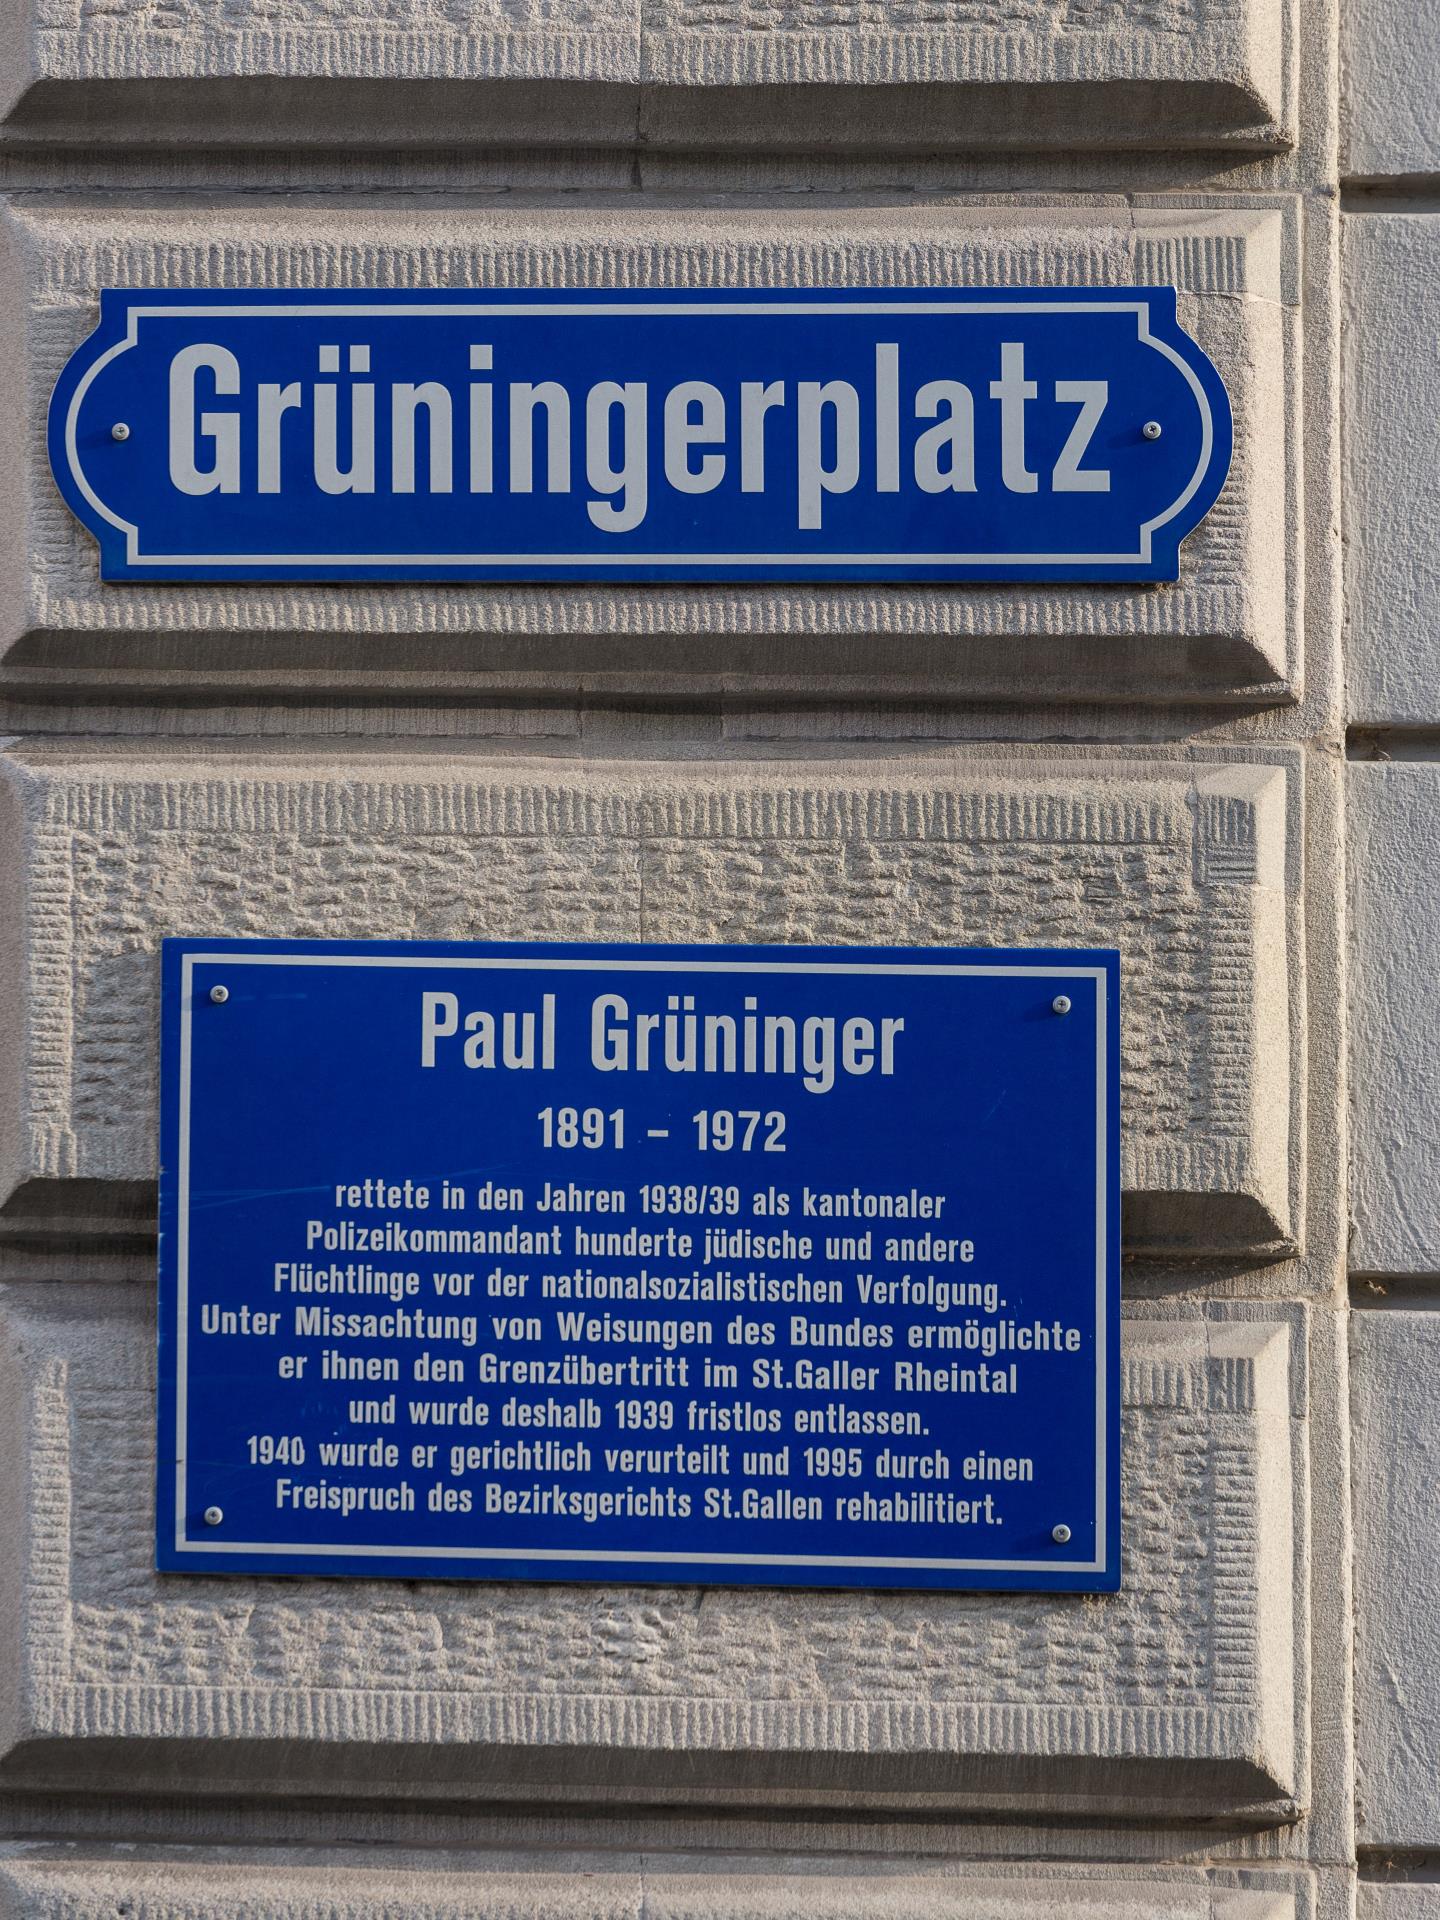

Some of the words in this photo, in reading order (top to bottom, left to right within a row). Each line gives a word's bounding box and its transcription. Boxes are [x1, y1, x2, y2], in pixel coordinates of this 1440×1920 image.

[170, 343, 1110, 532] Grüningerplatz
[422, 992, 555, 1069] Paul
[592, 994, 904, 1093] Grüninger
[538, 1108, 623, 1148] 1891
[693, 1111, 785, 1151] 1972
[336, 1179, 429, 1209] rettete
[443, 1181, 464, 1209] in
[479, 1182, 523, 1210] den
[537, 1183, 624, 1212] Jahren
[640, 1185, 739, 1214] 1938/39
[753, 1187, 789, 1215] als
[804, 1187, 945, 1218] kantonaler
[307, 1221, 561, 1254] Polizeikommandant
[576, 1226, 692, 1257] hunderte
[704, 1229, 812, 1264] jüdische
[826, 1232, 871, 1260] und
[886, 1233, 973, 1262] andere
[275, 1263, 419, 1301] Flüchtlinge
[433, 1274, 474, 1295] vor
[488, 1268, 529, 1296] der
[543, 1269, 842, 1303] nationalsozialistischen
[857, 1275, 1006, 1313] Verfolgung.
[202, 1305, 280, 1334] Unter
[296, 1307, 476, 1346] Missachtung
[493, 1318, 541, 1340] von
[557, 1312, 712, 1350] Weisungen
[728, 1315, 775, 1345] des
[791, 1317, 893, 1347] Bundes
[909, 1320, 1080, 1356] ermöglichte
[279, 1357, 307, 1378] er
[323, 1350, 398, 1380] ihnen
[414, 1352, 463, 1381] den
[480, 1353, 688, 1386] Grenzübertritt
[705, 1358, 737, 1387] im
[753, 1359, 879, 1390] St.Galler
[896, 1362, 1016, 1393] Rheintal
[350, 1395, 395, 1423] und
[409, 1396, 488, 1425] wurde
[502, 1397, 600, 1428] deshalb
[616, 1400, 673, 1429] 1939
[688, 1401, 781, 1432] fristlos
[795, 1404, 928, 1435] entlassen.
[248, 1436, 305, 1465] 1940
[319, 1438, 398, 1467] wurde
[412, 1446, 437, 1468] er
[451, 1440, 590, 1475] gerichtlich
[605, 1444, 729, 1474] verurteilt
[744, 1446, 788, 1475] und
[804, 1448, 861, 1477] 1995
[876, 1449, 949, 1479] durch
[964, 1451, 1032, 1480] einen
[277, 1479, 414, 1516] Freispruch
[429, 1483, 472, 1512] des
[486, 1484, 691, 1522] Bezirksgerichts
[705, 1488, 822, 1520] St.Gallen
[837, 1492, 1002, 1524] rehabilitiert.
